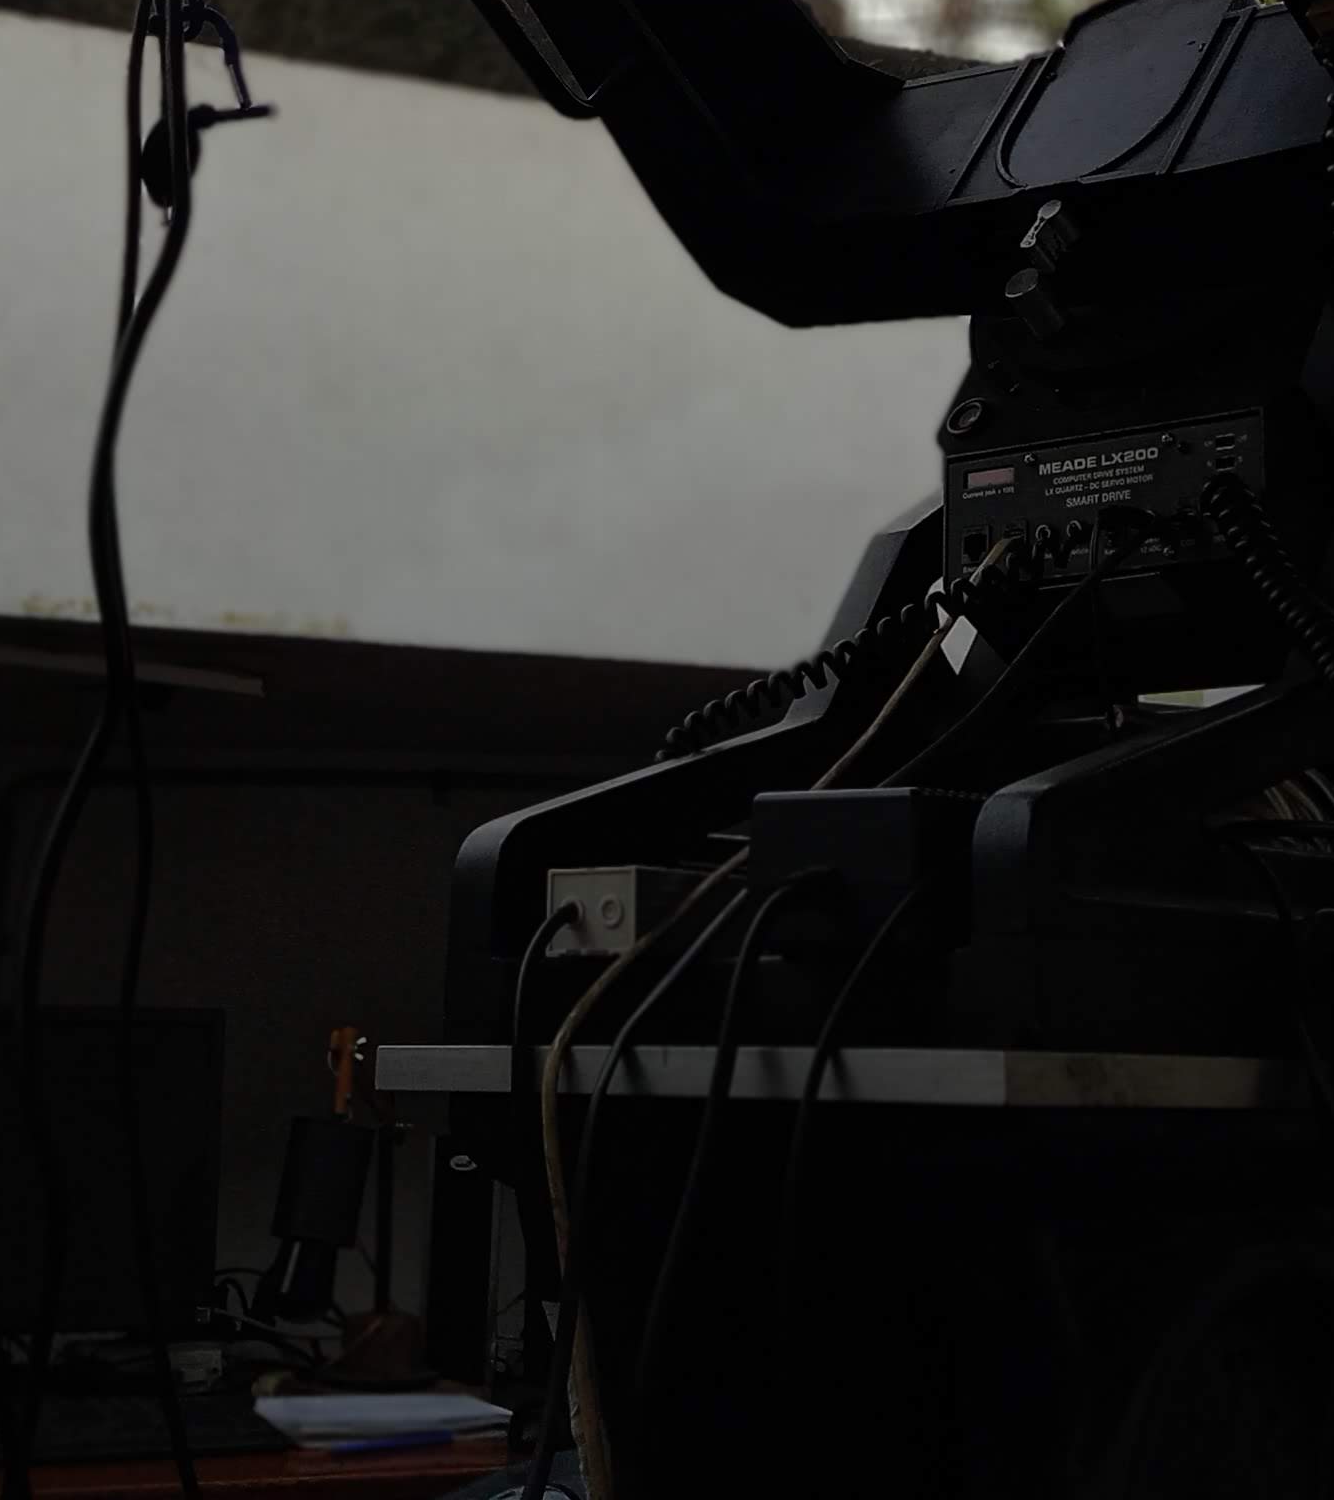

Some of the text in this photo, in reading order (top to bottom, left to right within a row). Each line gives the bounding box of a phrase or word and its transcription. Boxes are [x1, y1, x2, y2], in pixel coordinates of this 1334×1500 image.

[1038, 446, 1159, 476] MEADE LX200
[1053, 465, 1145, 485] COMPUTER DRIVE SYSTEM
[1055, 484, 1083, 495] QUARTZ
[1090, 481, 1100, 491] DC
[1101, 477, 1124, 489] SERVO
[1126, 474, 1154, 485] MOTOR
[1066, 489, 1132, 508] SMART DRIVE
